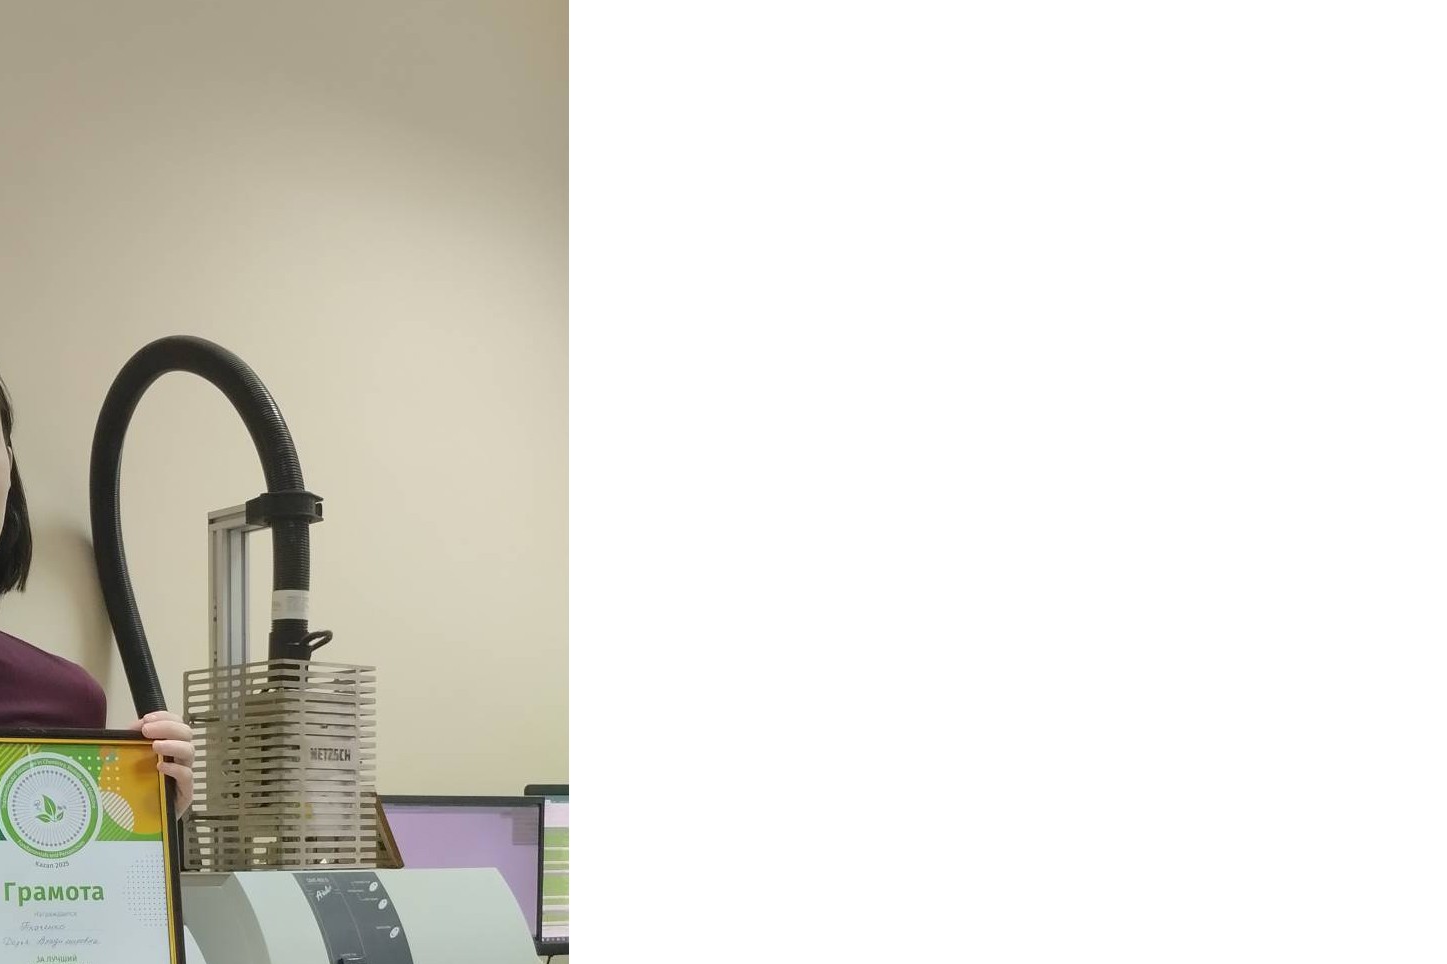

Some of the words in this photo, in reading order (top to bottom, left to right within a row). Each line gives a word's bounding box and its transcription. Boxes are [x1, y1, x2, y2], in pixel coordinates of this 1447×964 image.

[310, 747, 351, 761] NETZSCH
[4, 882, 105, 907] Грамота
[36, 955, 45, 963] ЗА
[46, 954, 78, 963] ЛУЧШИЙ
